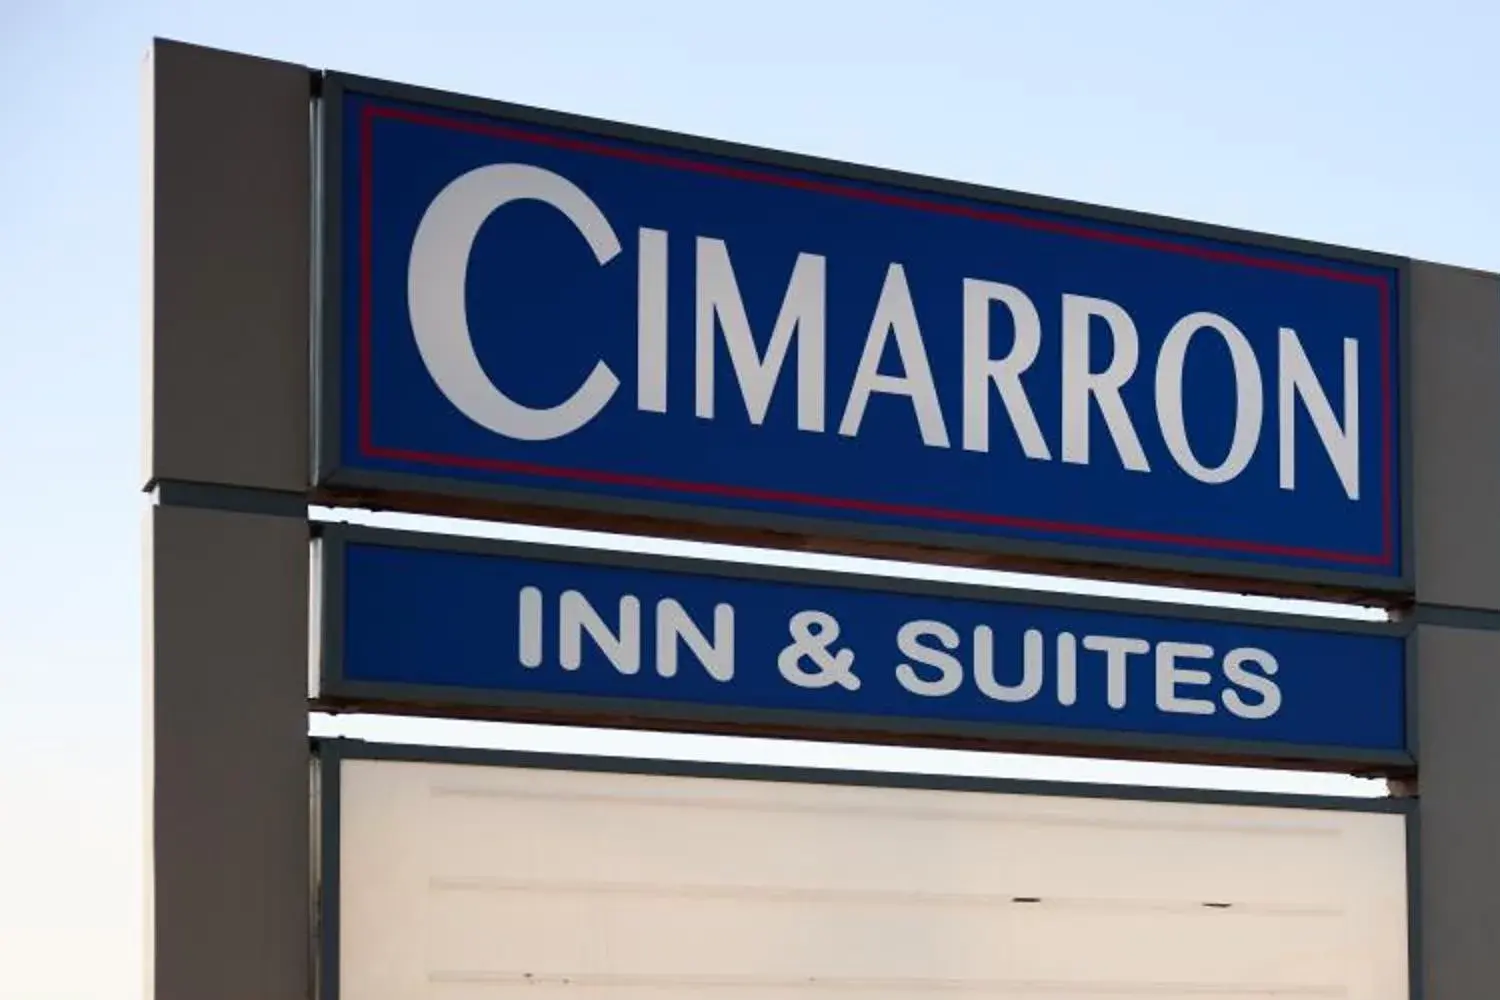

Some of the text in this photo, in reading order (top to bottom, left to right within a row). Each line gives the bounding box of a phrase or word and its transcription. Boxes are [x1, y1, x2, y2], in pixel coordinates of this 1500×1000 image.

[408, 164, 1358, 499] CIMARRON
[520, 587, 1280, 718] INN & SUITES
